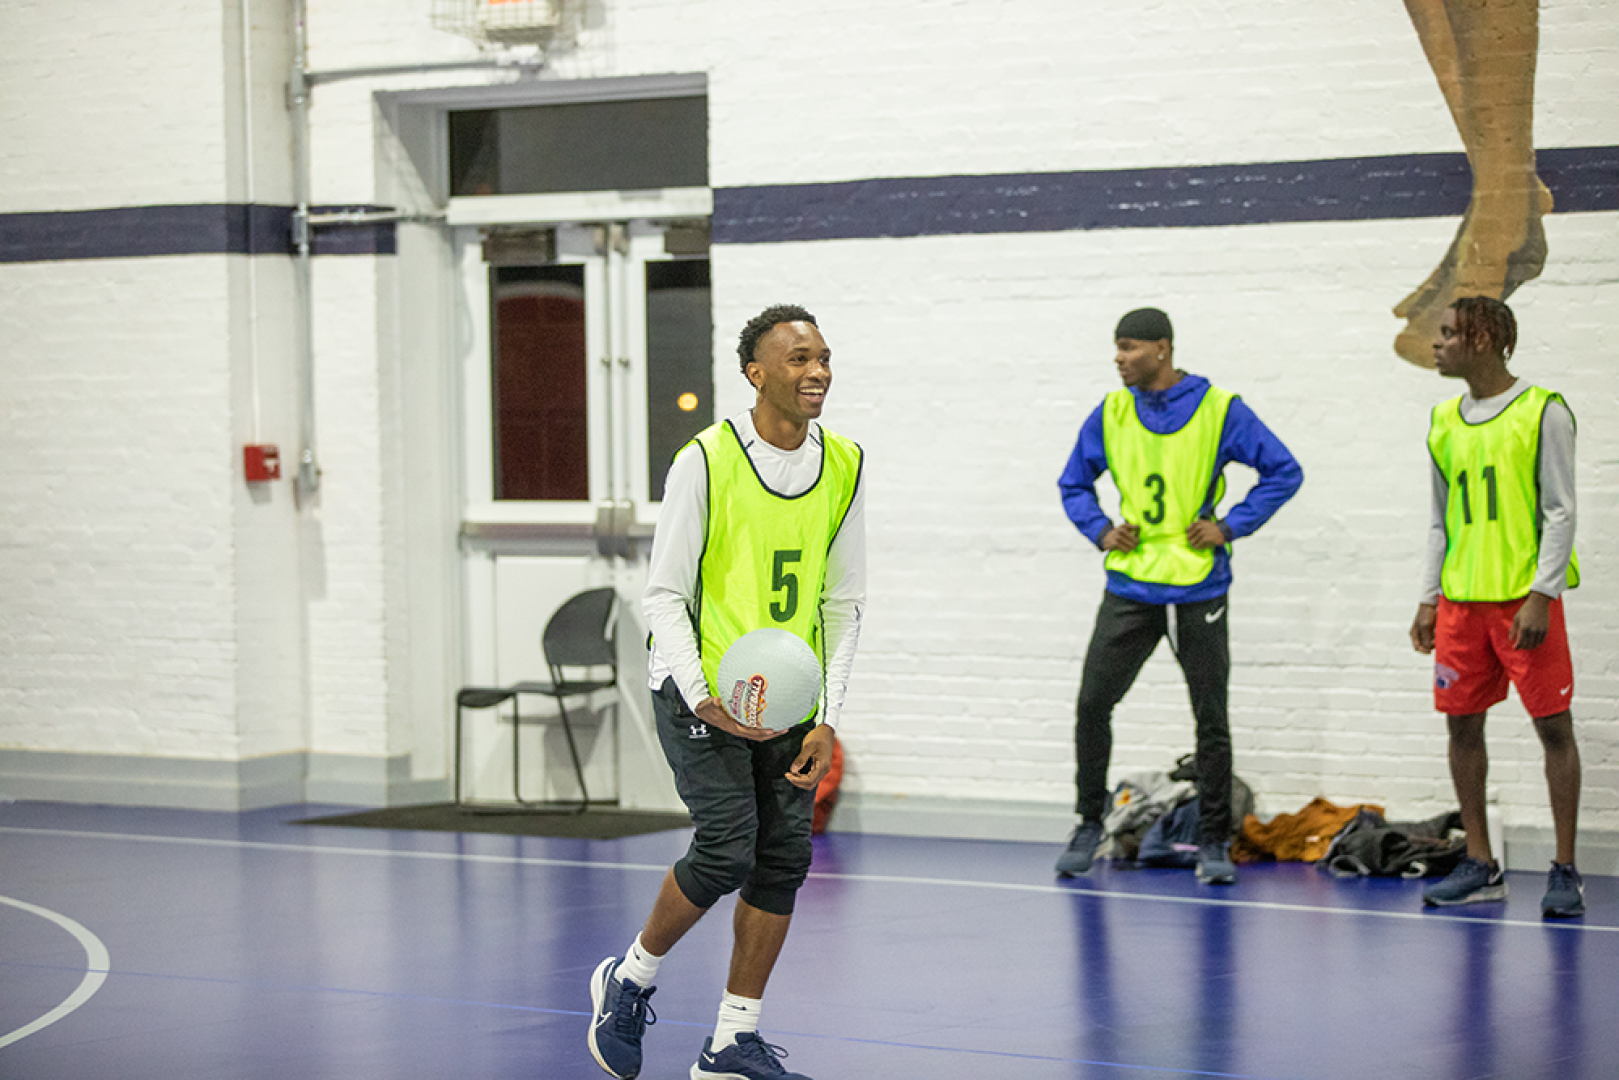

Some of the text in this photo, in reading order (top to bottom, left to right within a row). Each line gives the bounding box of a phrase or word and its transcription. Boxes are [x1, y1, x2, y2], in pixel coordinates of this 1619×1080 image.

[1142, 473, 1166, 525] 3
[1457, 465, 1498, 525] 11
[769, 549, 802, 622] 5
